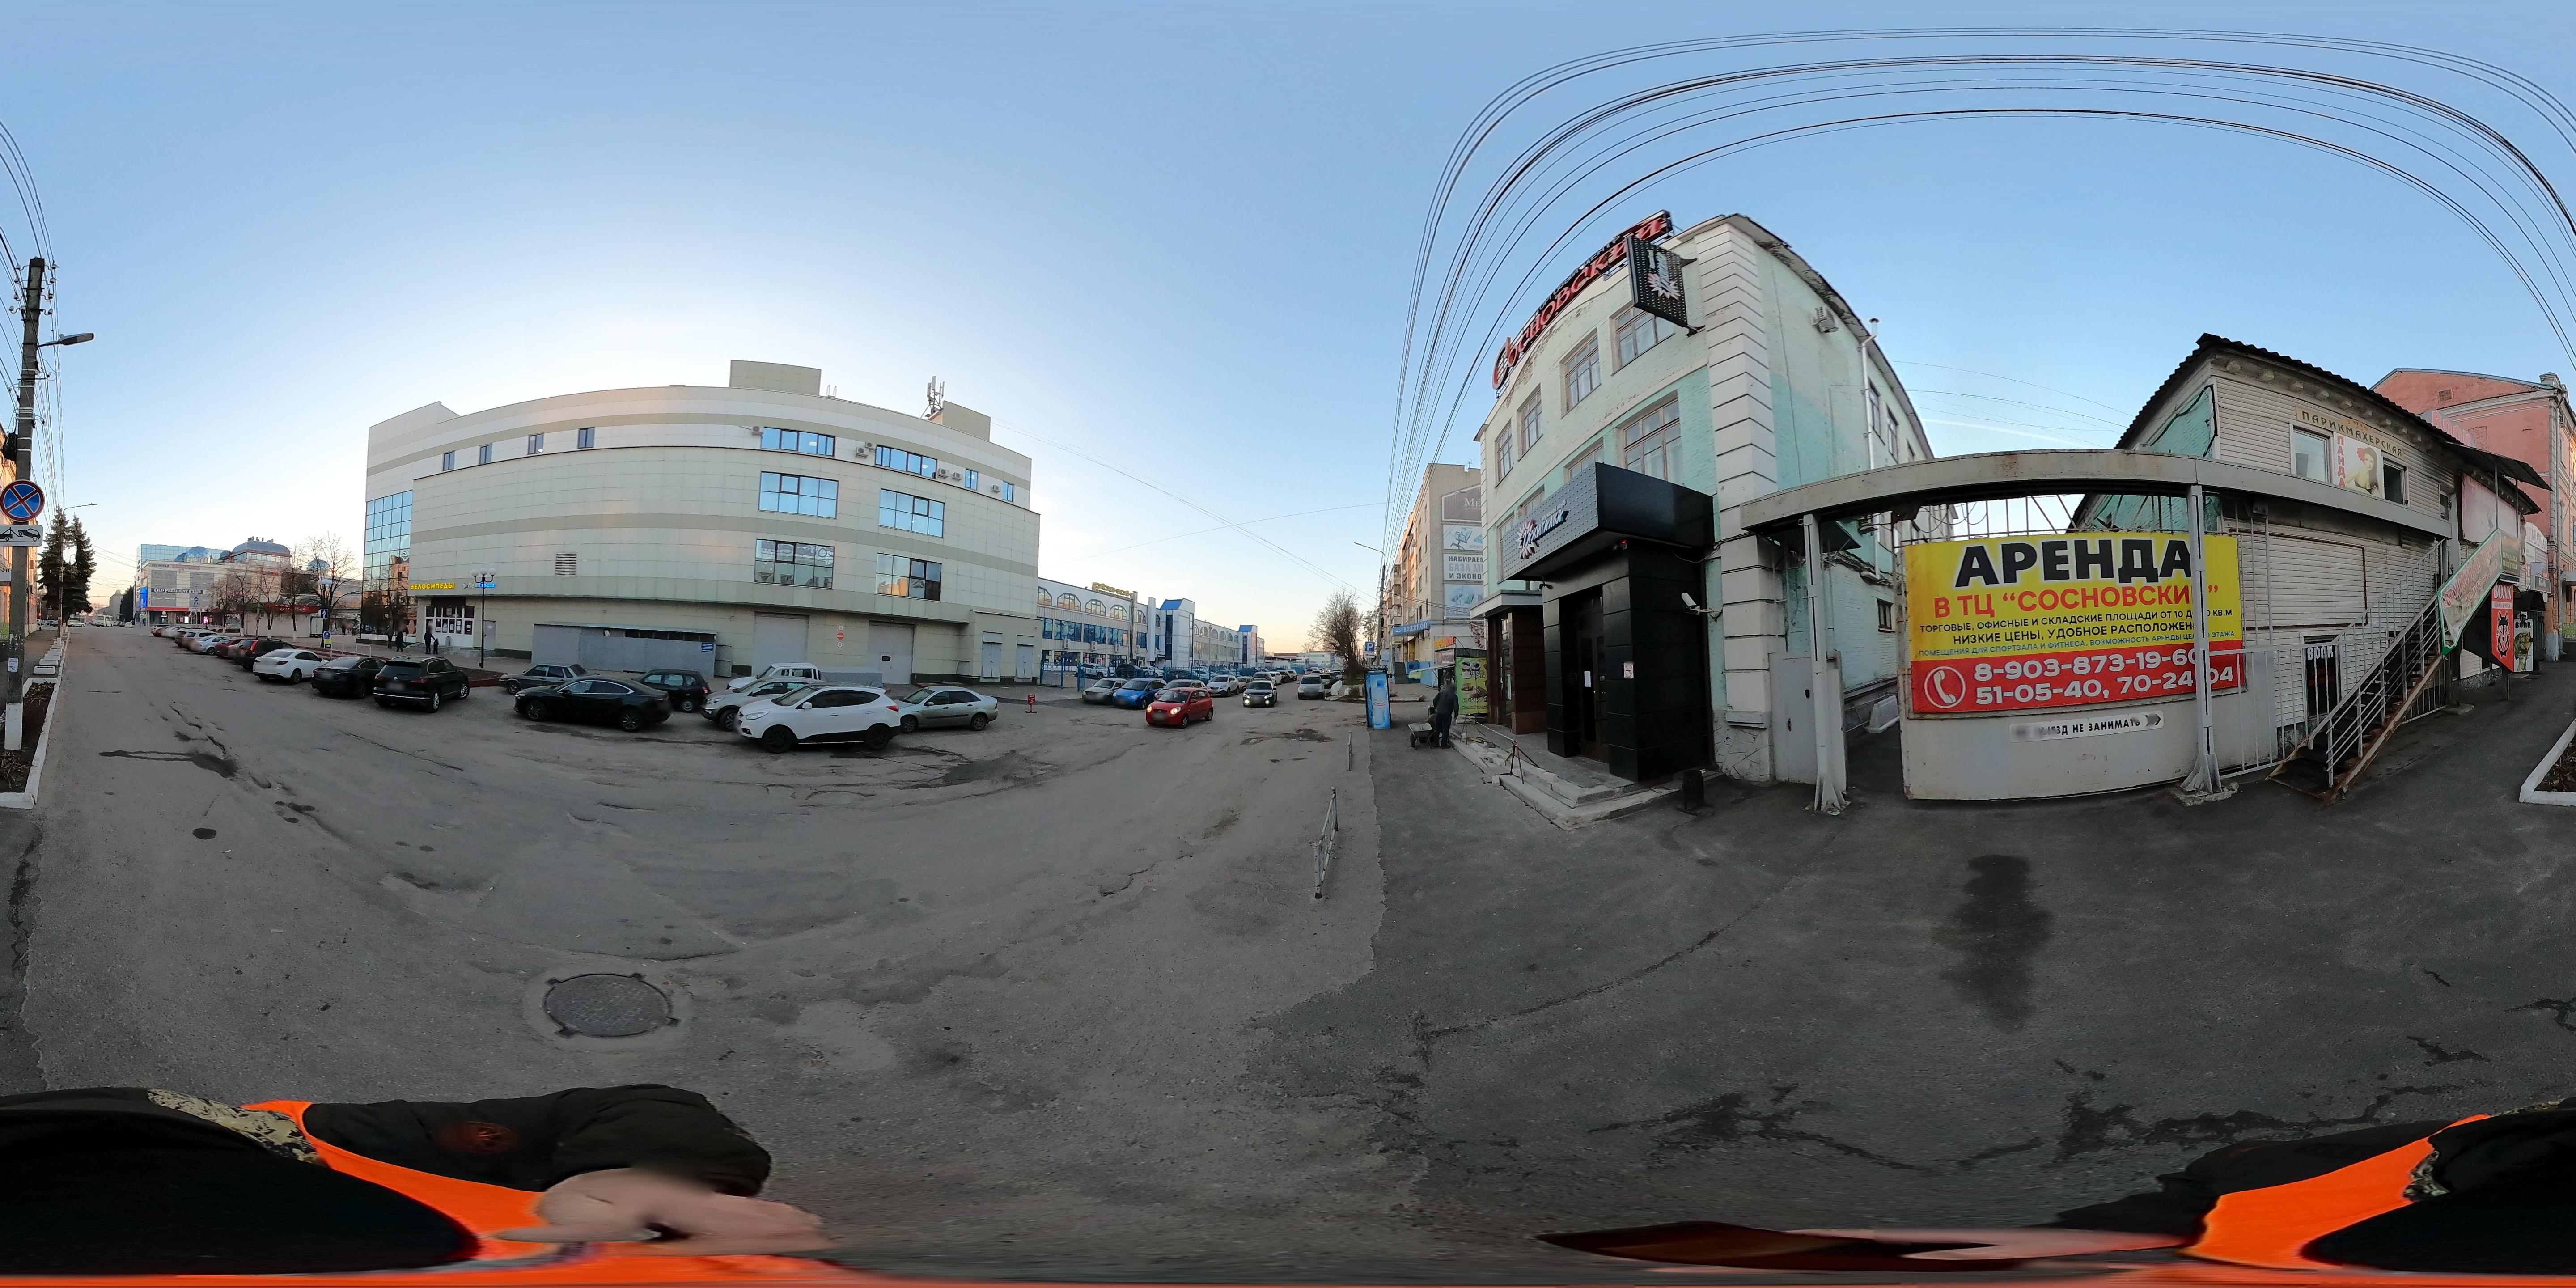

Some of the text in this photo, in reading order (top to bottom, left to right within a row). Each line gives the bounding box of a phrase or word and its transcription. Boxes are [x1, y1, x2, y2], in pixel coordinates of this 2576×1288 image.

[2302, 411, 2402, 457] ПАРИКМАХЕРСКАЯ
[2337, 436, 2346, 487] ПАНДА
[1449, 564, 1470, 572] БАЗА
[1955, 539, 2191, 587] АРЕНДА
[2494, 584, 2512, 600] ВОЛК
[1934, 597, 1950, 618] В
[1957, 594, 1995, 617] ТЦ
[1920, 623, 1974, 633] ТОРГОВЫЕ,
[1977, 619, 2028, 629] ОФИСНЫЕ
[2041, 614, 2103, 625] СКЛАДСКИЕ
[2106, 611, 2157, 622] ПЛОЩАДИ
[1953, 632, 2000, 644] НИЗКИЕ
[2005, 630, 2043, 642] ЦЕНЫ,
[2047, 626, 2107, 639] УДОБНОЕ
[1919, 648, 1969, 657] ПОМЕЩЕНИЯ
[1990, 644, 2037, 652] СПОРТЗАЛА
[2048, 640, 2088, 649] ФИТНЕСА.
[2090, 636, 2149, 646] ВОЗМОЖНОСТЬ
[1975, 679, 2108, 705] 51-05-40,
[2072, 724, 2084, 733] НЕ
[2089, 718, 2140, 731] ЗАНИМАТЬ
